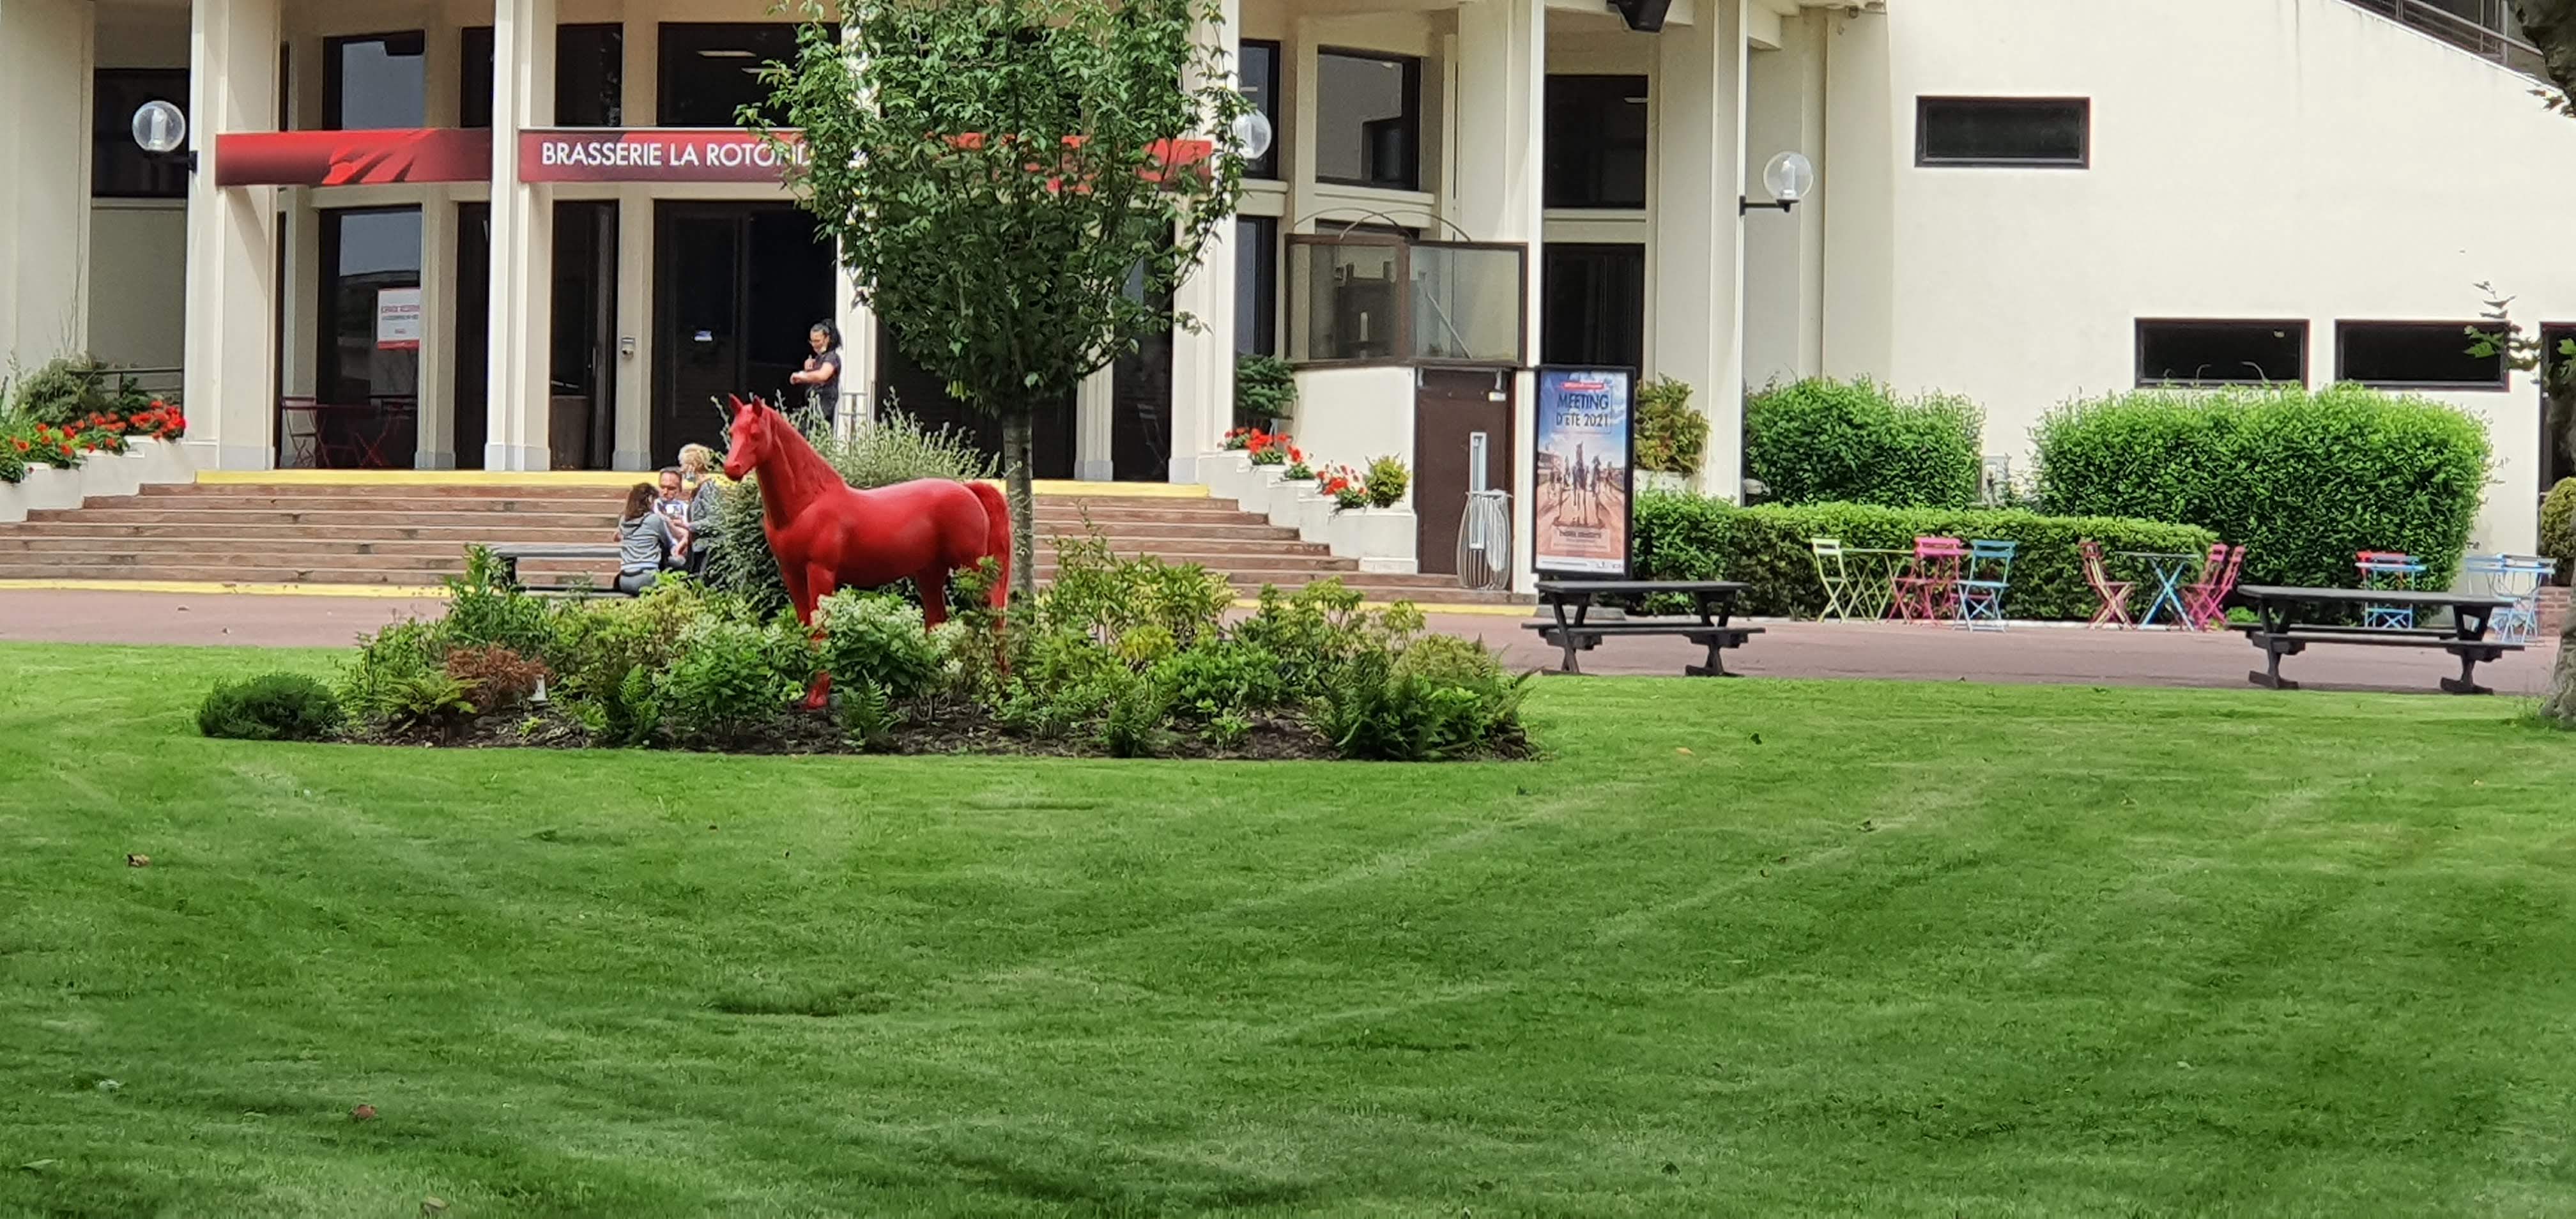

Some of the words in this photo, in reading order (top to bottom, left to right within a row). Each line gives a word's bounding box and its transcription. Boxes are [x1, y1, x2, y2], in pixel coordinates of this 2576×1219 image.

[542, 142, 662, 166] BRASSERIE
[670, 142, 699, 166] LA
[706, 142, 812, 167] ROTOND
[1557, 393, 1609, 410] MEETING
[1584, 413, 1608, 427] 2021
